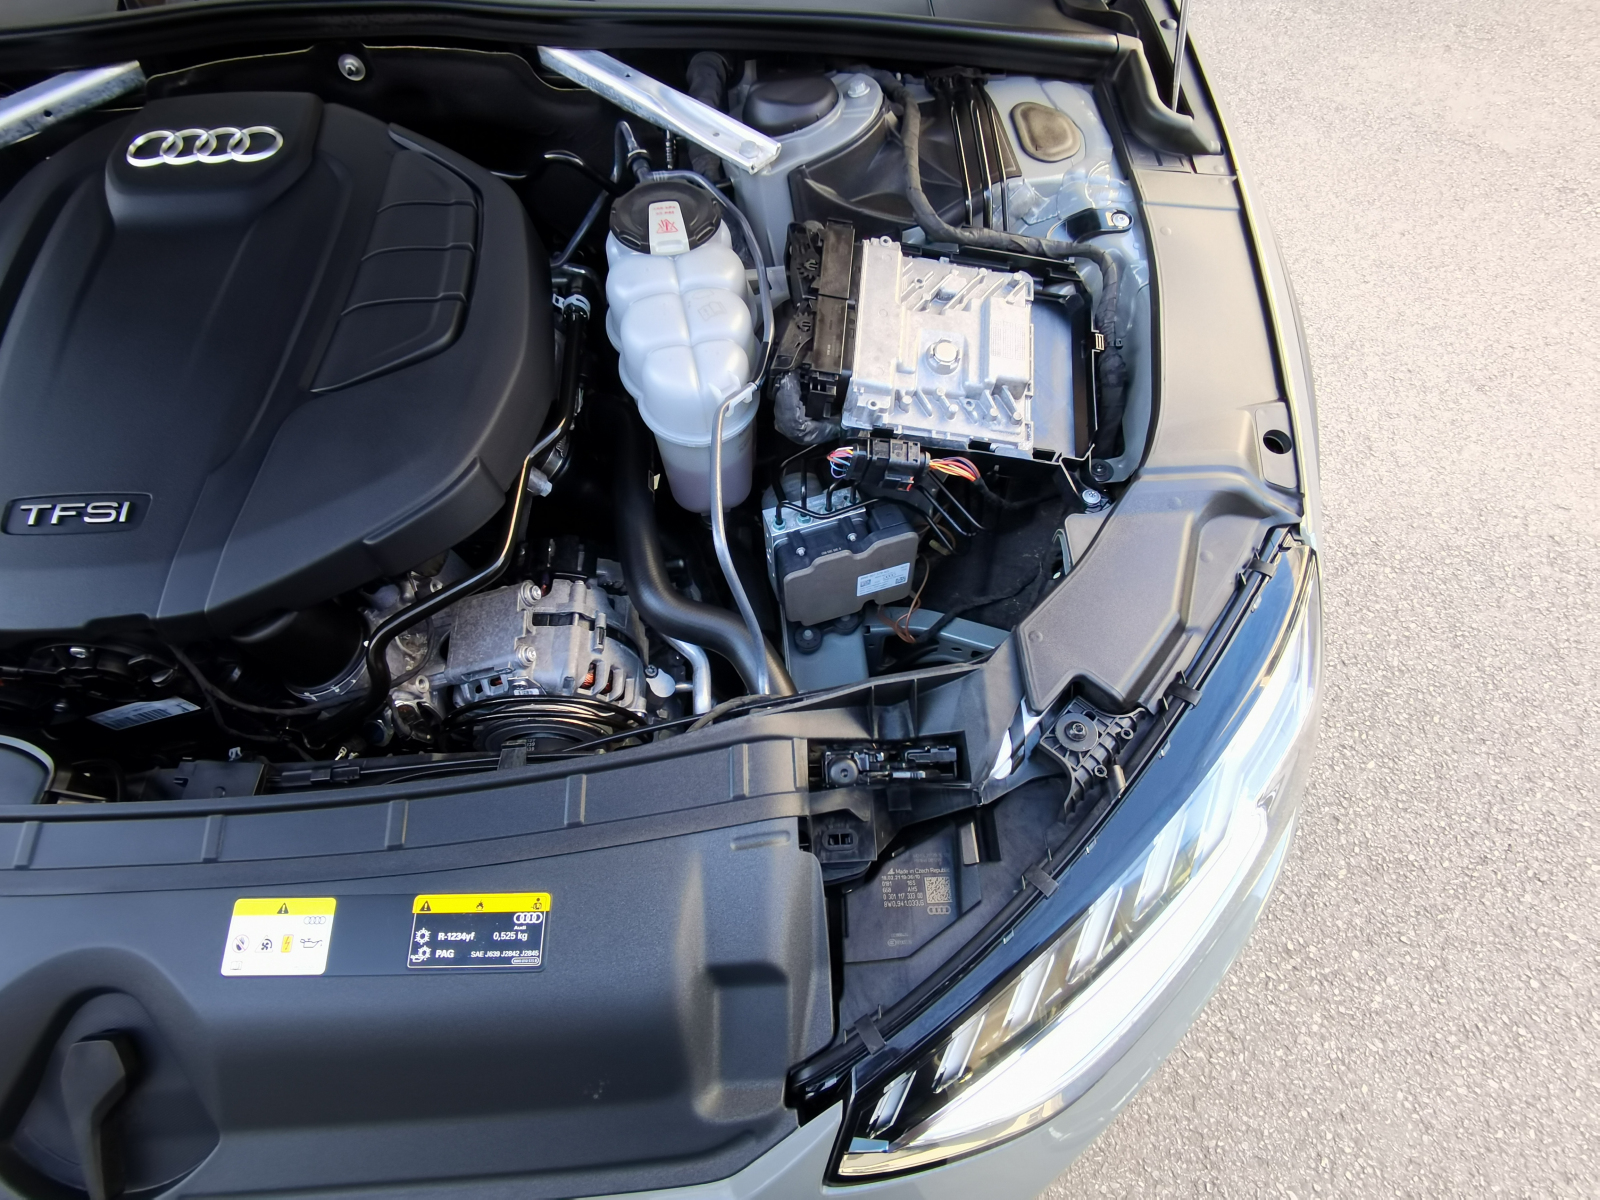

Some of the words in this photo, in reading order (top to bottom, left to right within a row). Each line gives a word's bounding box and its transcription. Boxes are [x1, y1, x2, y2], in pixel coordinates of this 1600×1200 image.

[20, 501, 130, 525] TFSI
[438, 932, 475, 942] R-1234yf
[493, 932, 516, 941] 0,525
[517, 931, 528, 941] kg
[436, 950, 454, 958] PAG
